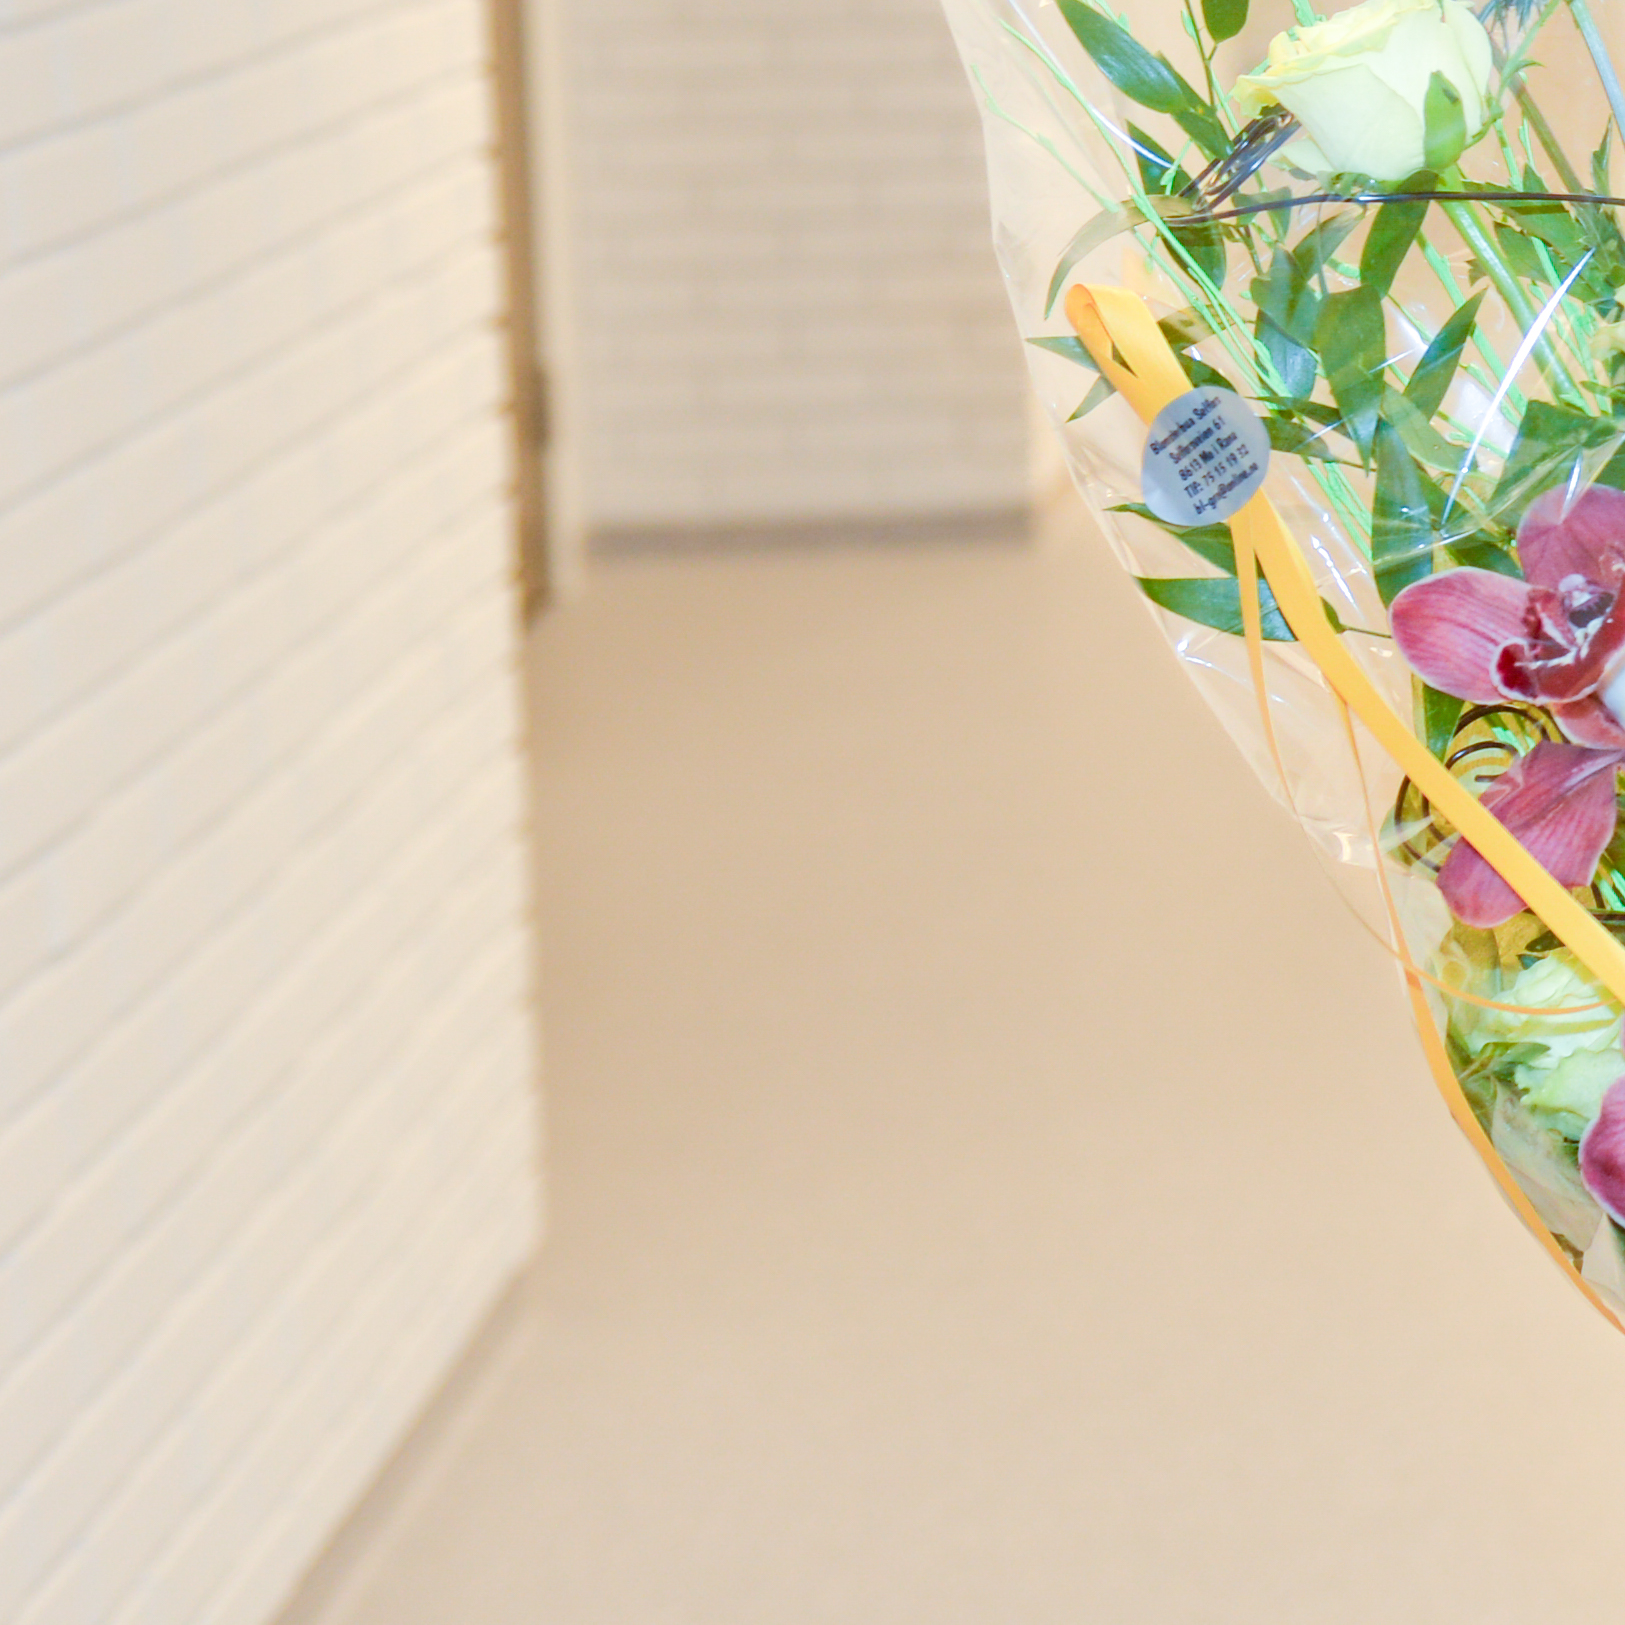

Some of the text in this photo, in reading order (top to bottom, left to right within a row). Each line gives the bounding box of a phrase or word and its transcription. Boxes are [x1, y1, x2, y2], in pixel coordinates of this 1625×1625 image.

[1212, 415, 1225, 430] 61
[1179, 458, 1202, 481] 8613
[1199, 450, 1214, 464] Mo
[1216, 431, 1237, 450] Rana
